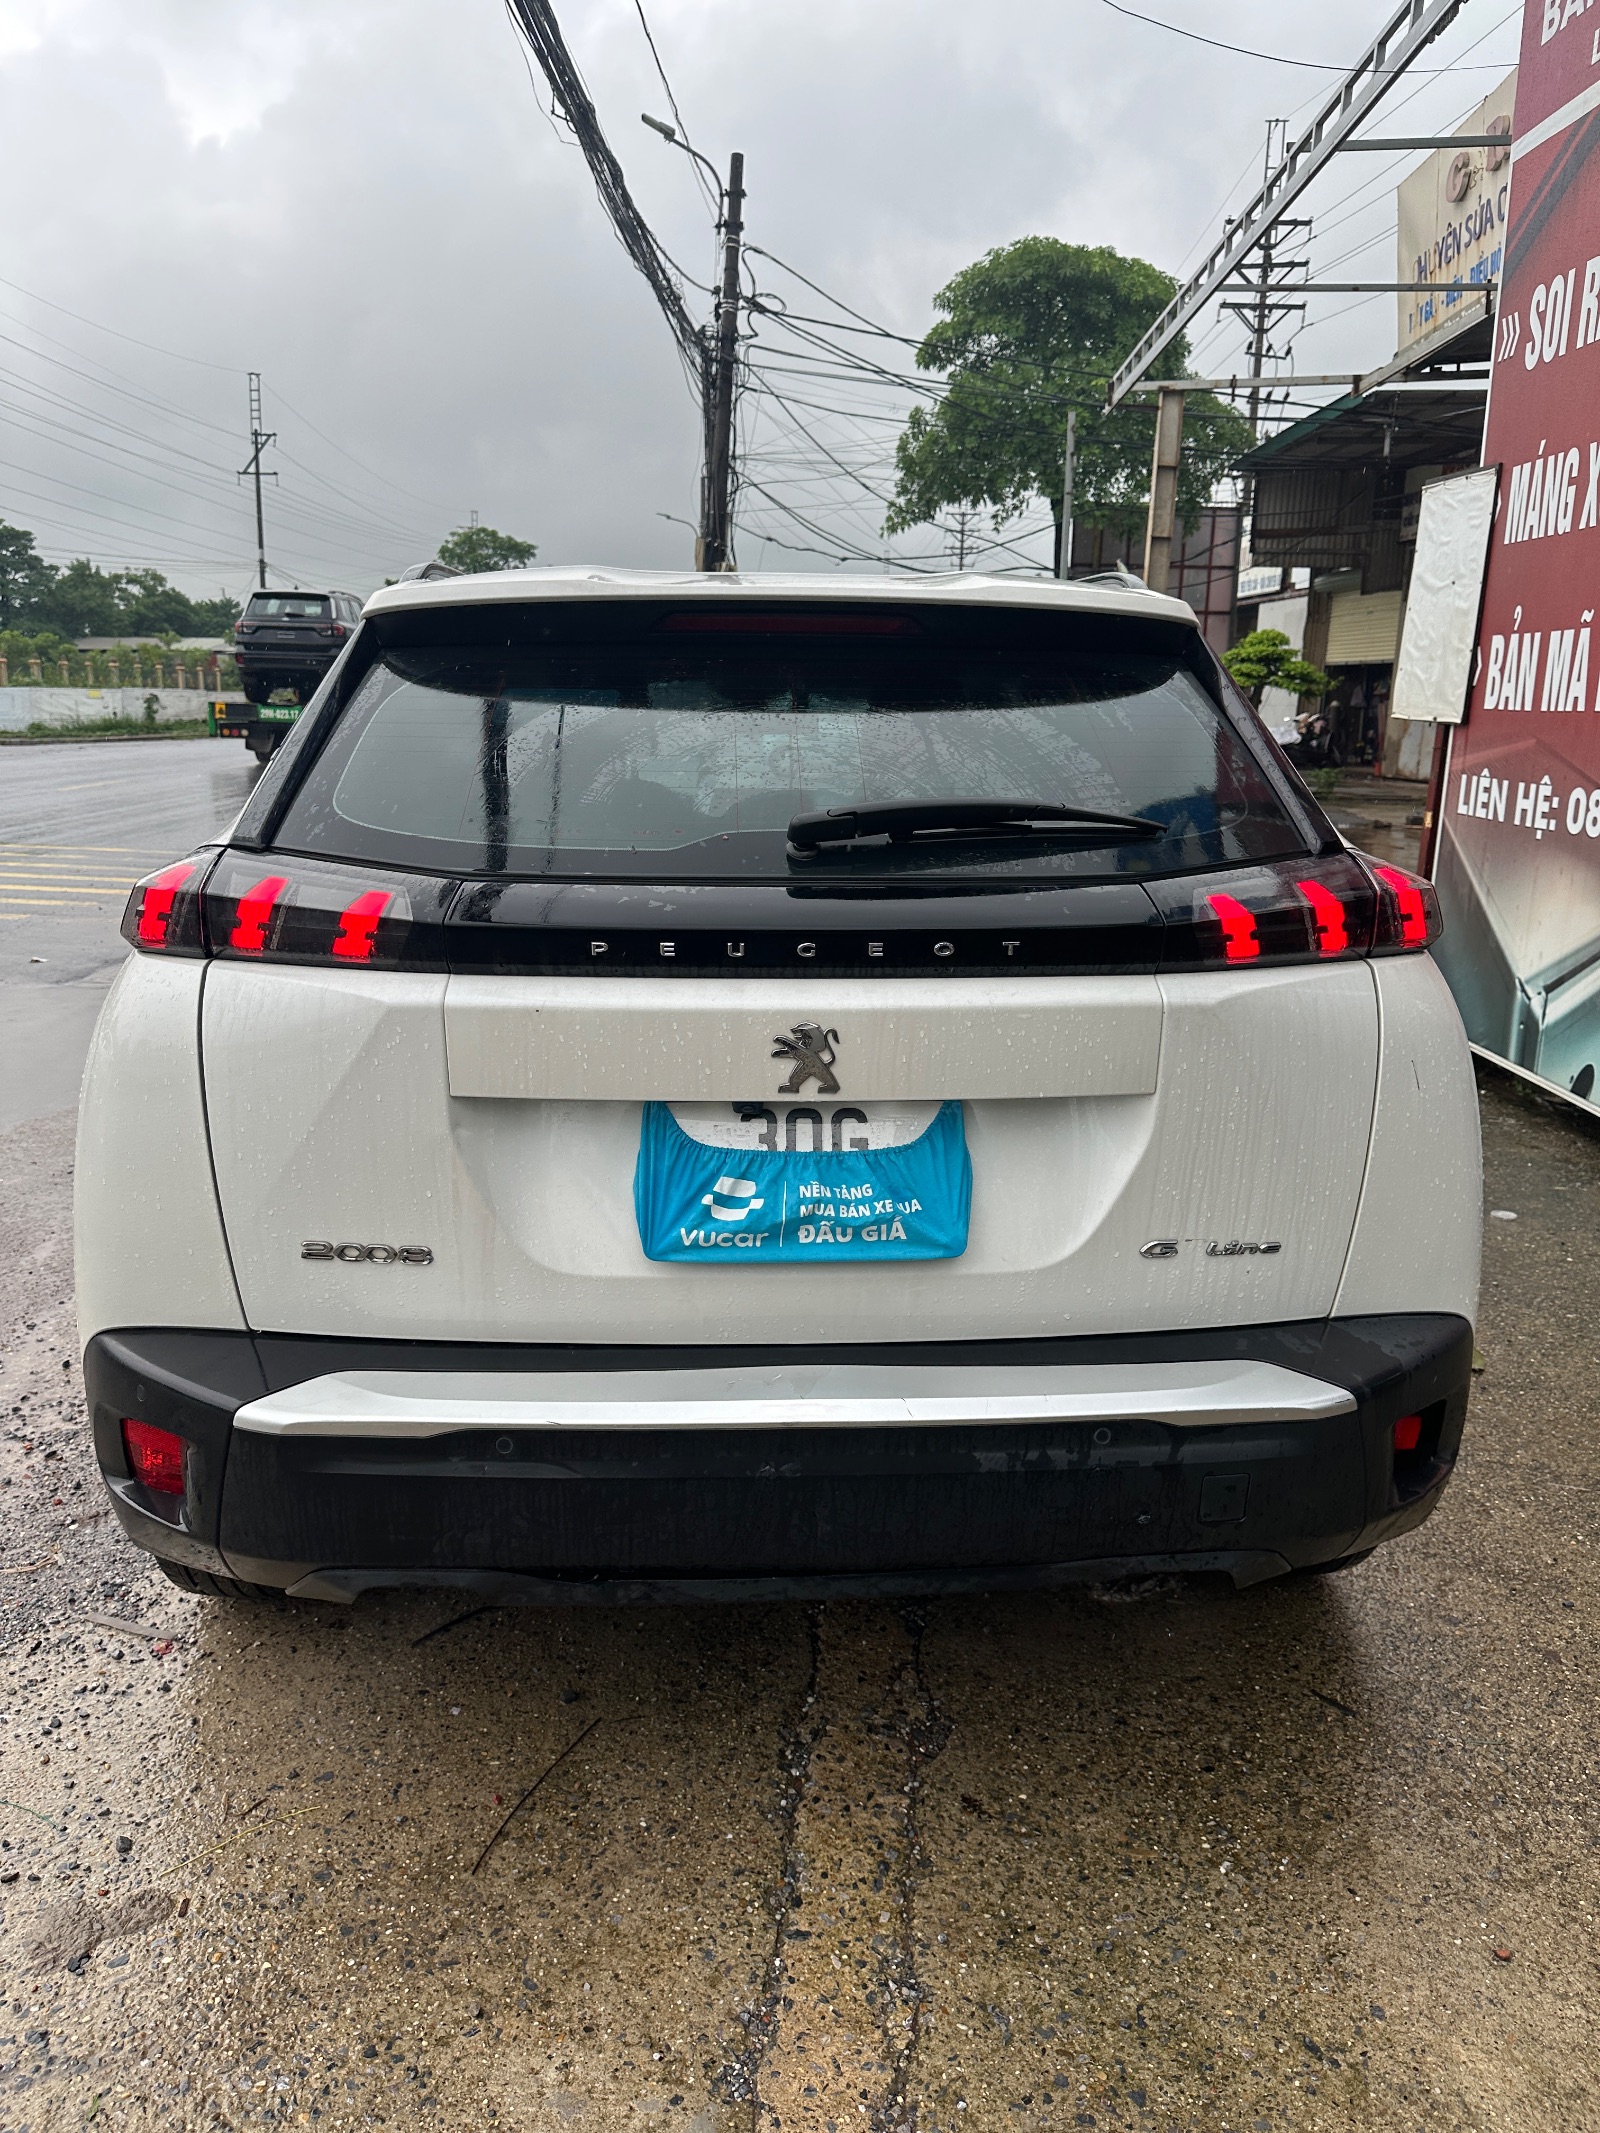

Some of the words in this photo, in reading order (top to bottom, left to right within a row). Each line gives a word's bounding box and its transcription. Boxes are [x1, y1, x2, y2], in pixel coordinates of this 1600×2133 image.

[1414, 222, 1462, 284] HUYÊN
[1525, 268, 1577, 371] SOI
[1577, 255, 1600, 349] R
[1503, 439, 1580, 545] MÁNG
[1484, 605, 1541, 711] BẢN
[1541, 609, 1594, 712] MÃ
[1457, 768, 1509, 823] LIÊN
[1513, 775, 1560, 840] HỆ:
[591, 941, 1020, 957] PEUGEOT
[799, 1180, 832, 1198] NỀN
[833, 1183, 873, 1200] TẢNG
[799, 1203, 835, 1218] MUA
[839, 1203, 871, 1218] BÁN
[873, 1199, 894, 1215] XE
[798, 1219, 853, 1244] ĐẤU
[861, 1215, 907, 1242] GIÁ
[301, 1240, 434, 1265] 2008
[1206, 1240, 1281, 1256] Line
